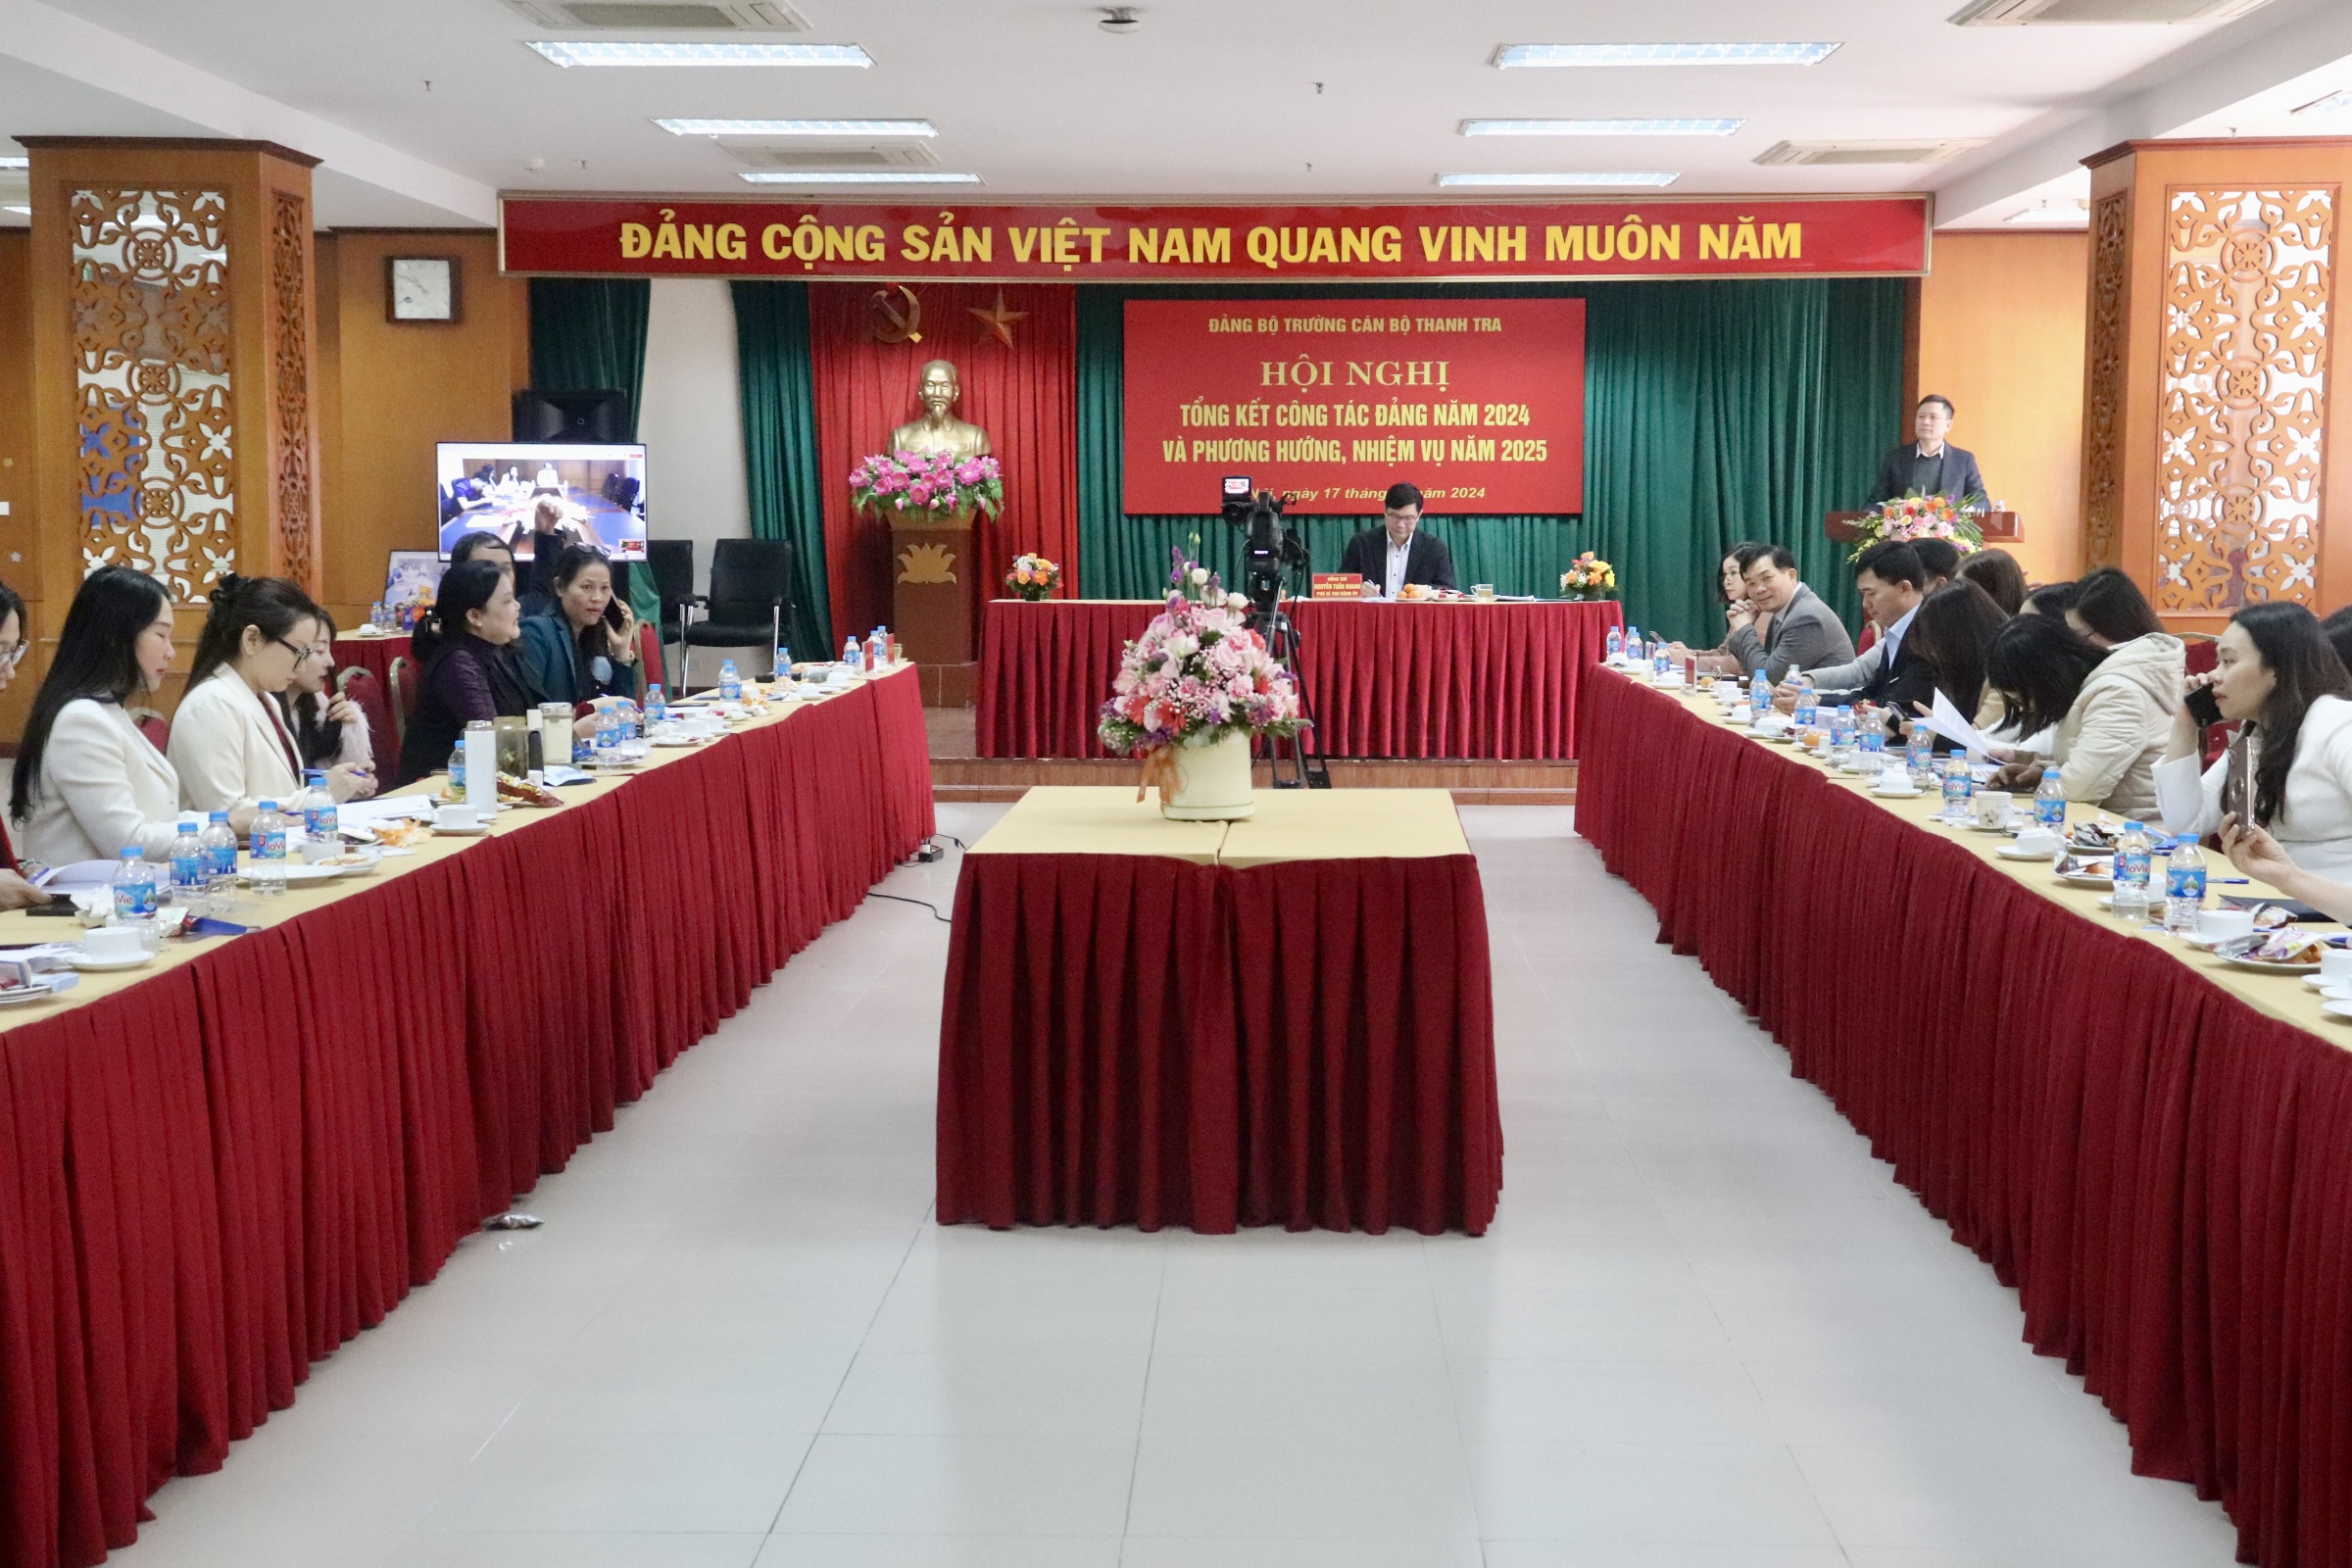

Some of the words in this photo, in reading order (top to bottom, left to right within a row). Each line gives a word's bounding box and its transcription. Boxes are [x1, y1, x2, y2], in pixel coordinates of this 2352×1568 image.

[619, 208, 746, 260] ĐẢNG
[761, 214, 885, 270] CỘNG
[901, 211, 993, 263] SẢN
[1008, 216, 1111, 271] VIỆT
[1129, 226, 1230, 264] NAM
[1247, 225, 1402, 270] QUANG
[1419, 225, 1528, 262] VINH
[1545, 214, 1681, 262] MUÔN
[1699, 215, 1802, 261] NĂM
[1208, 313, 1252, 333] ĐẢNG
[1257, 315, 1279, 335] BỘ
[1283, 315, 1348, 333] TRƯỜNG
[1350, 315, 1385, 333] CÁN
[1389, 315, 1411, 335] BỘ
[1415, 317, 1468, 332] THANH
[1472, 317, 1502, 332] TRA
[1260, 353, 1334, 394] HỘI
[1345, 361, 1450, 393] NGHỊ
[1180, 395, 1231, 427] TỔNG
[1236, 397, 1271, 427] KẾT
[1275, 399, 1328, 427] CÔNG
[1333, 399, 1370, 427] TÁC
[1375, 396, 1428, 427] ĐẢNG
[1433, 399, 1479, 427] NĂM
[1483, 403, 1531, 427] 2024
[1162, 435, 1188, 463] VÀ
[1192, 437, 1270, 463] PHƯƠNG
[1276, 435, 1348, 466] HƯỚNG,
[1352, 434, 1415, 467] NHIỆM
[1420, 438, 1446, 467] VỤ
[1450, 434, 1495, 463] NĂM
[1500, 438, 1548, 463] 2025
[1281, 487, 1319, 502] ngày
[1323, 487, 1342, 499] 17
[1345, 487, 1387, 502] tháng
[1420, 487, 1446, 499] ăm
[1450, 487, 1487, 499] 2024
